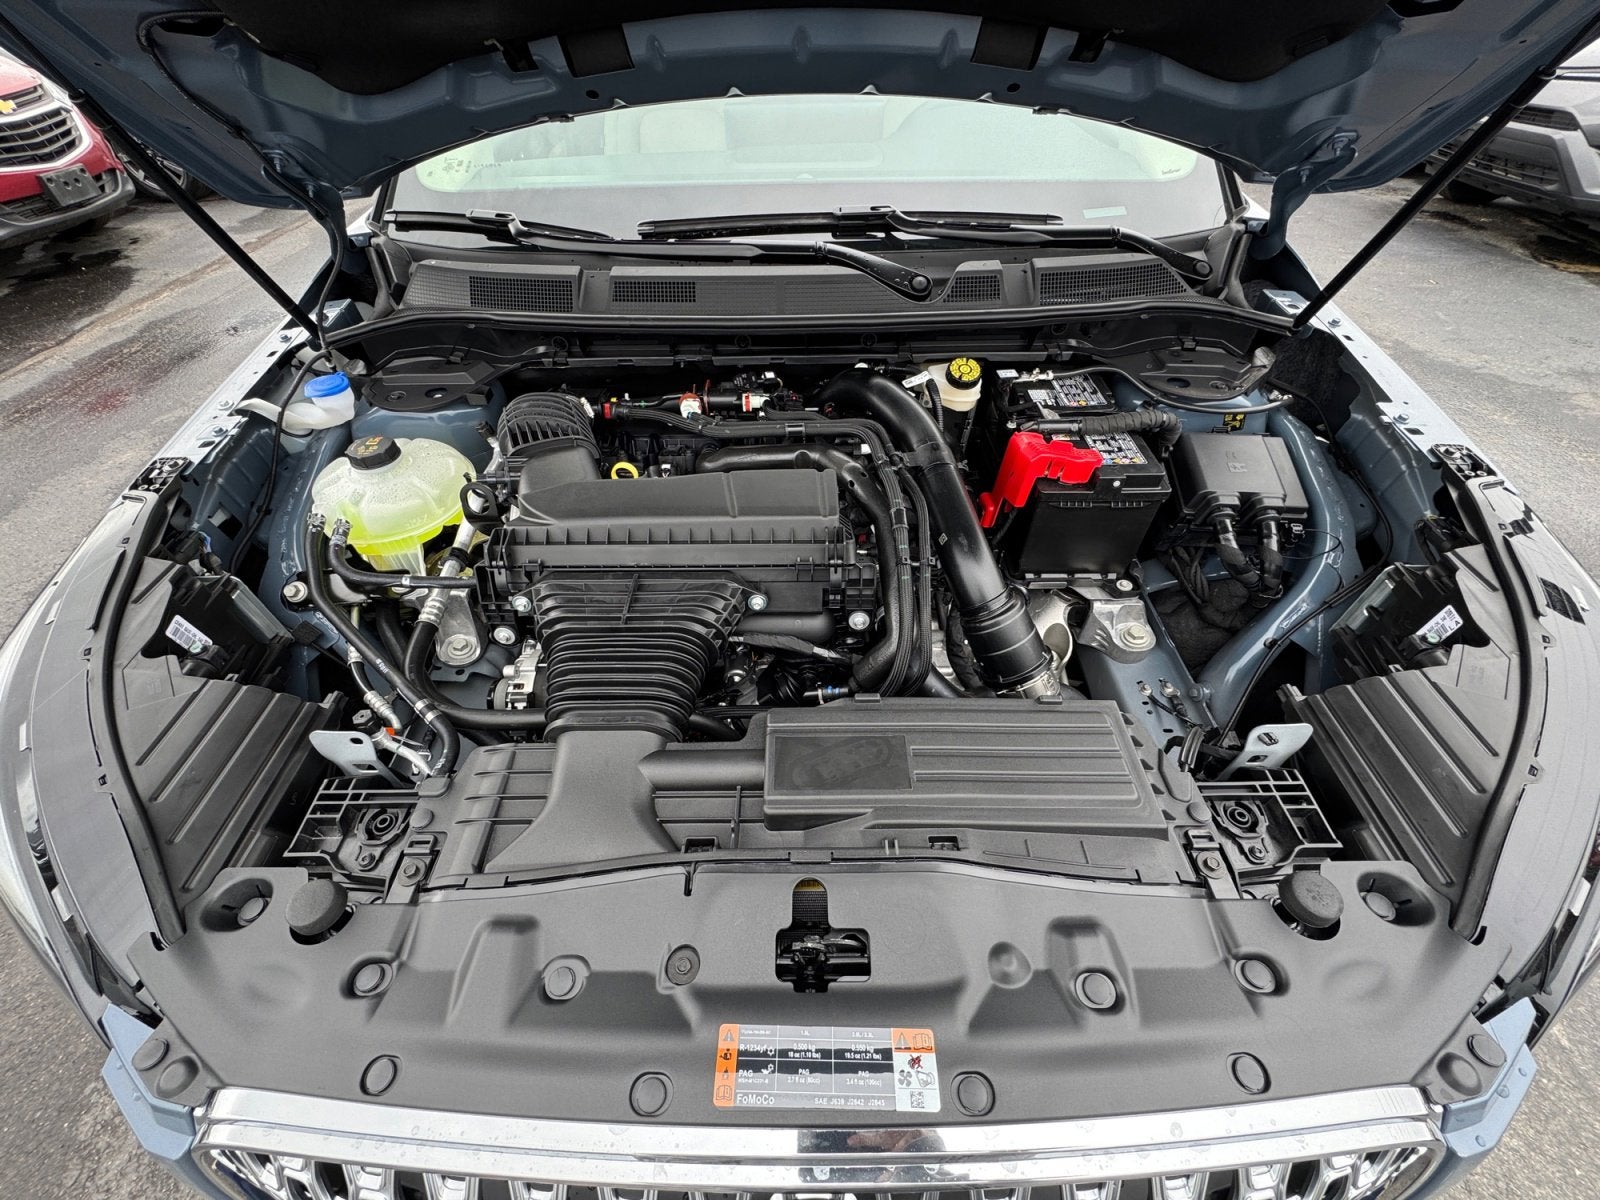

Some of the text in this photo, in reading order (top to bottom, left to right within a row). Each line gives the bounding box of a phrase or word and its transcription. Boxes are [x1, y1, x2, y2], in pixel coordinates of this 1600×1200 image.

[740, 1043, 767, 1053] R-1234yf
[808, 1043, 816, 1052] kg
[866, 1044, 874, 1053] kg
[738, 1069, 753, 1077] PAG
[798, 1068, 810, 1076] PAG
[736, 1094, 775, 1105] FoMoCo
[814, 1097, 828, 1105] SAE
